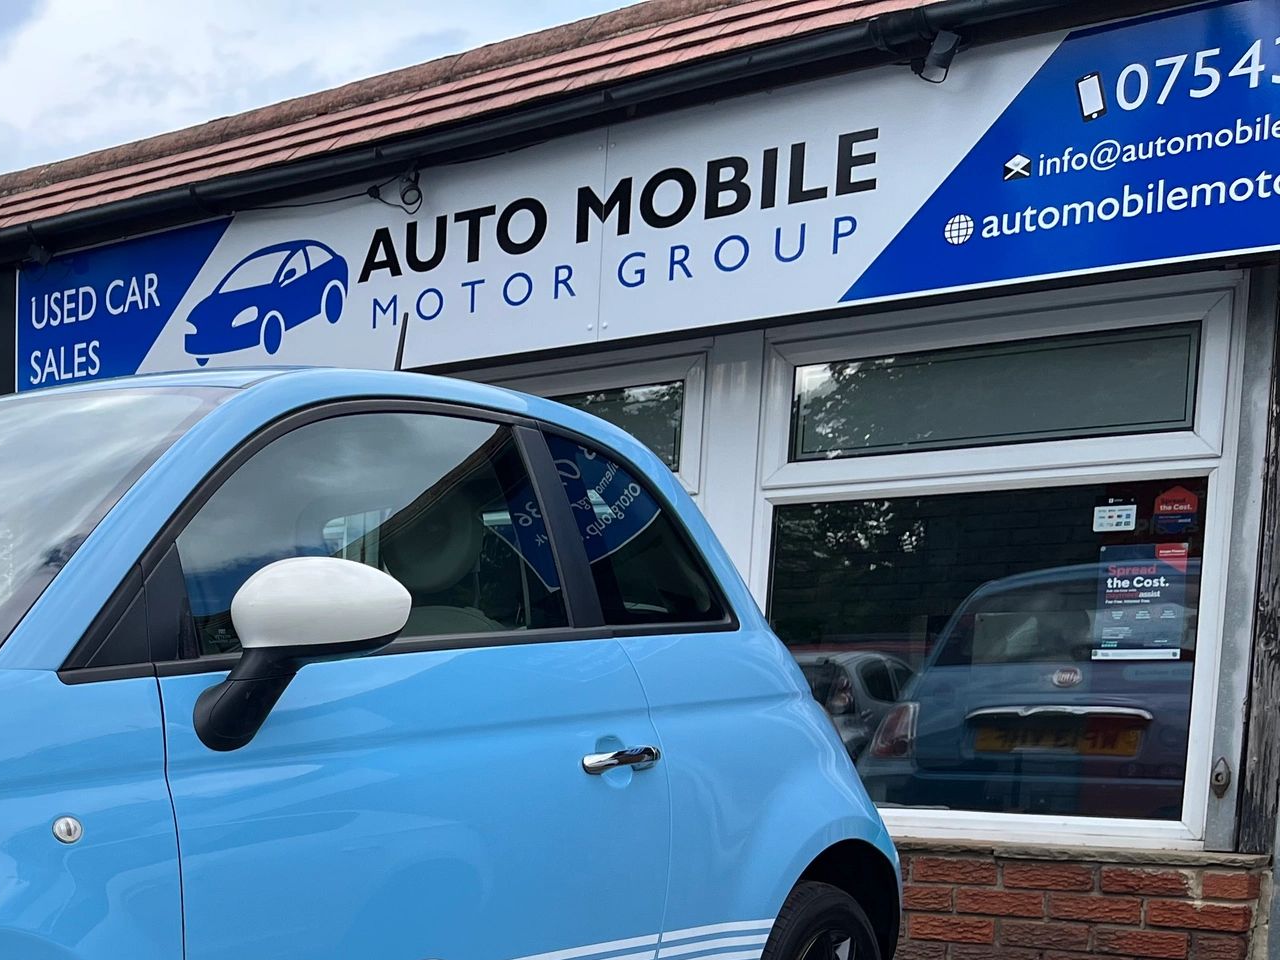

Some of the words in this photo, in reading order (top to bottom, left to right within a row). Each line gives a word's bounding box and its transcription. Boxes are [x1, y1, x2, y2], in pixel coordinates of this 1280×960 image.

[358, 197, 548, 283] AUTO
[576, 127, 879, 243] MOBILE
[371, 264, 576, 329] MOTOR
[617, 215, 858, 288] GROUP
[30, 287, 95, 329] USED
[105, 273, 160, 316] CAR
[30, 341, 100, 384] SALES
[1106, 577, 1131, 588] the
[1132, 576, 1170, 588] Cost.
[1108, 564, 1157, 577] Spread
